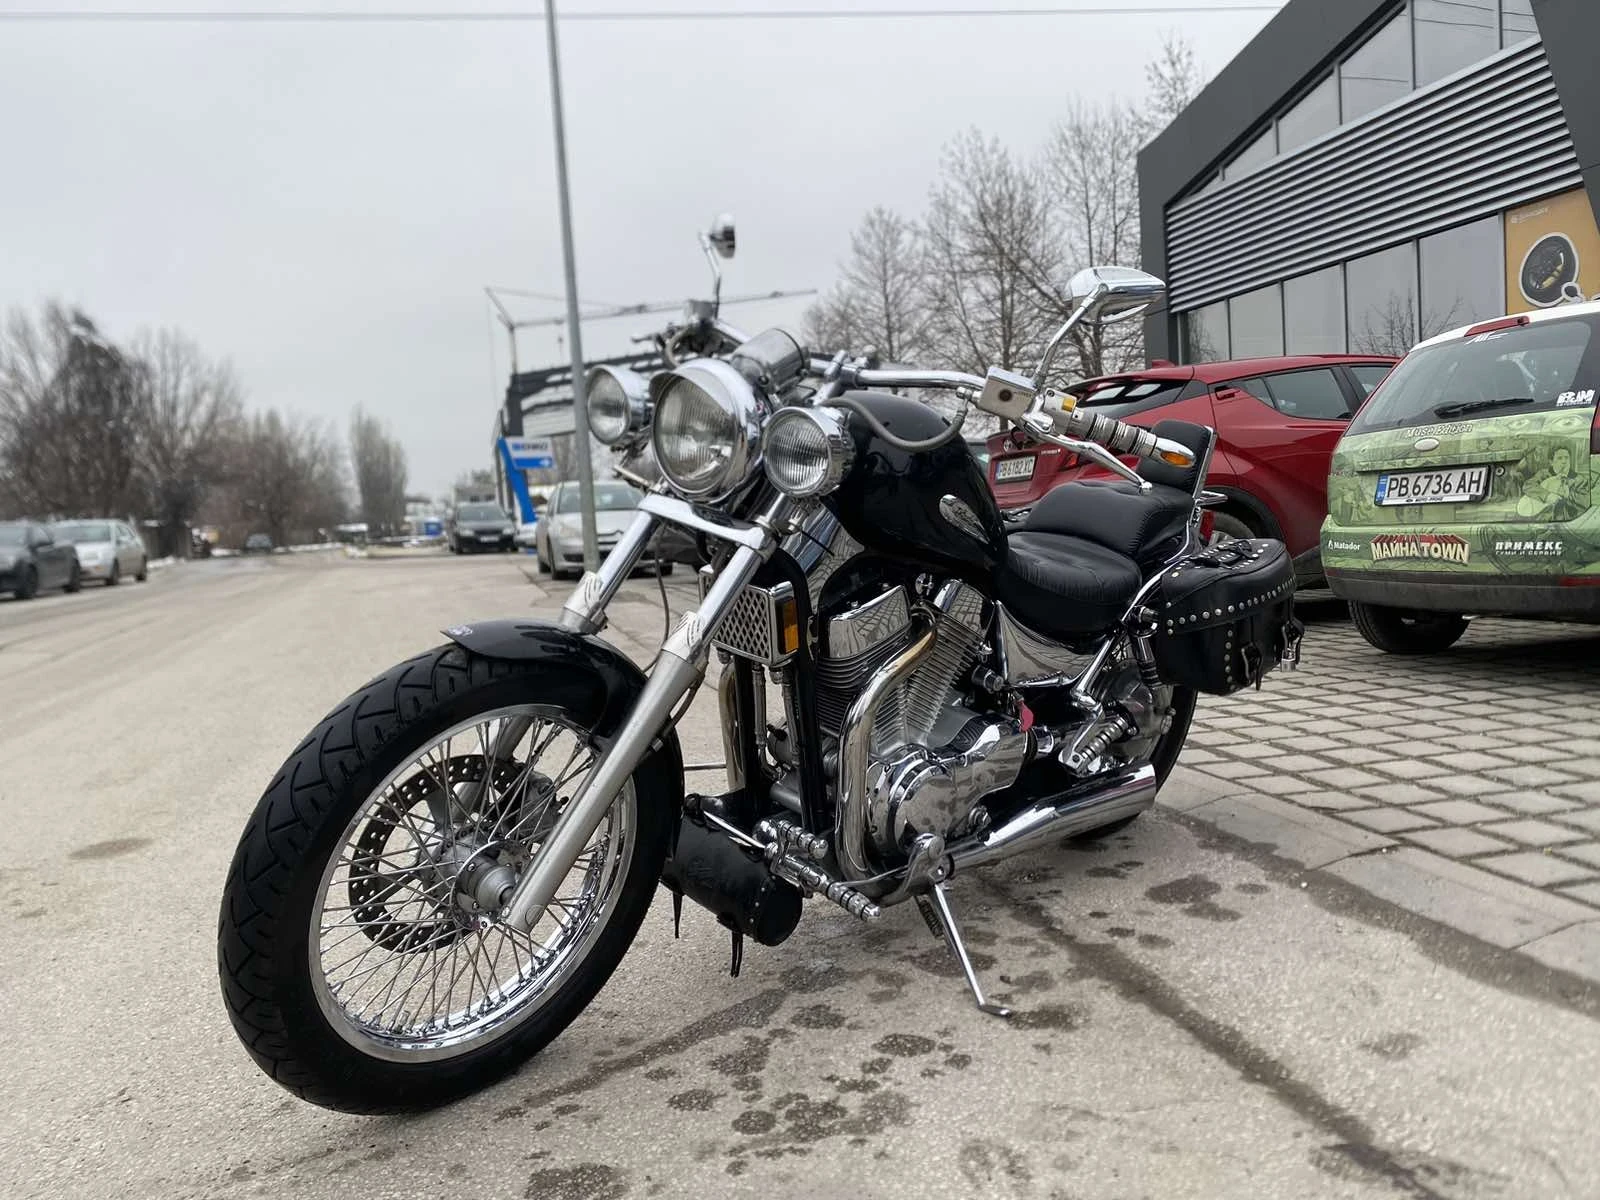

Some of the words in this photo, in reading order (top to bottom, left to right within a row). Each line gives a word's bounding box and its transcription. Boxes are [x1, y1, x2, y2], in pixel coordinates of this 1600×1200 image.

[1388, 477, 1410, 498] PB
[1412, 473, 1453, 496] 6736
[1456, 470, 1483, 494] AH
[1334, 541, 1361, 551] Matador
[1495, 541, 1563, 550] ПРИМЕКС
